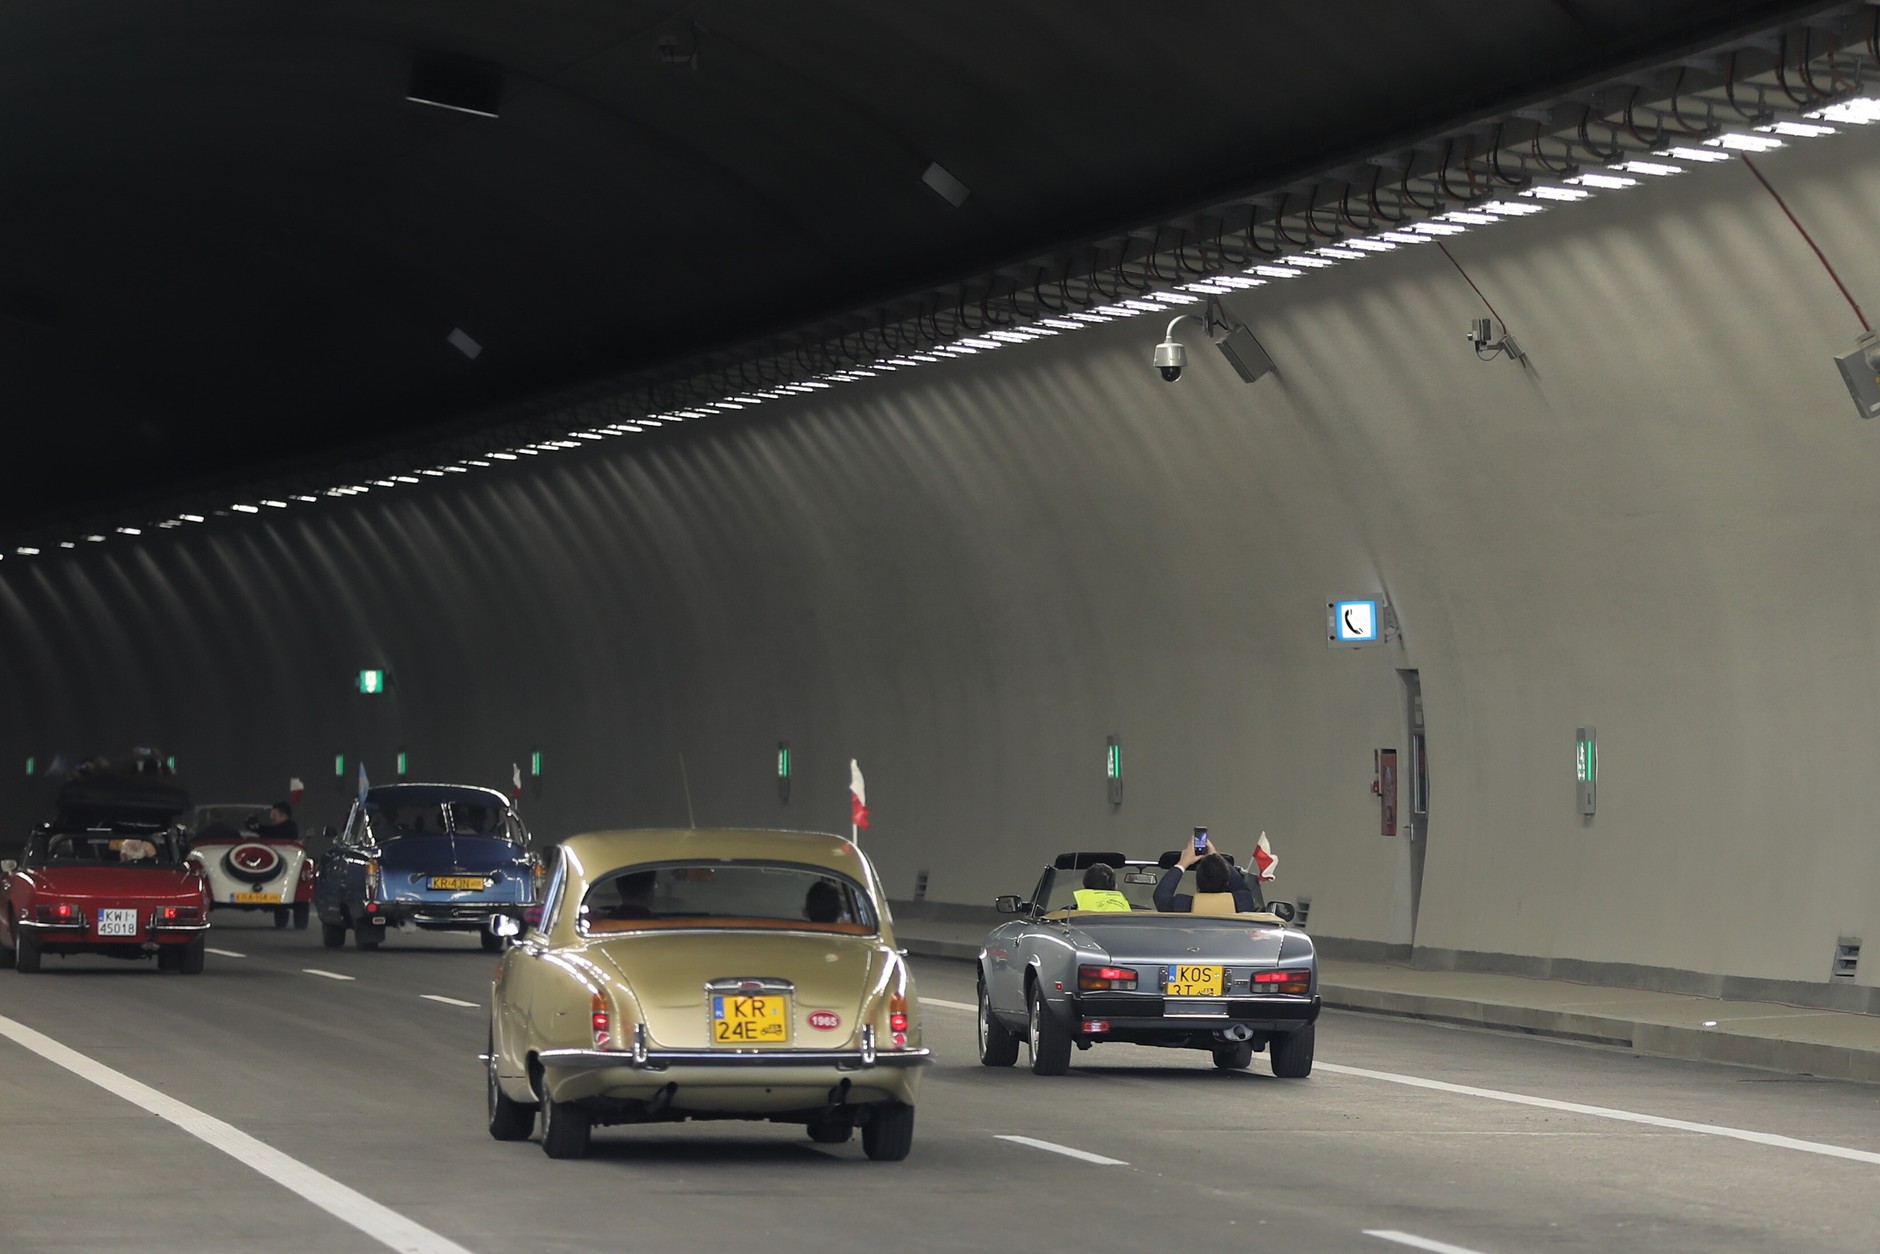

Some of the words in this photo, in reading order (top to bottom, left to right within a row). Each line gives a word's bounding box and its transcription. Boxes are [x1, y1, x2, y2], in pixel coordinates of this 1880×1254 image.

[433, 878, 448, 889] KR
[100, 923, 134, 934] 45018
[1180, 967, 1212, 983] KOS
[734, 999, 766, 1018] KR
[811, 1015, 838, 1027] 1965
[718, 1021, 757, 1040] 24E
